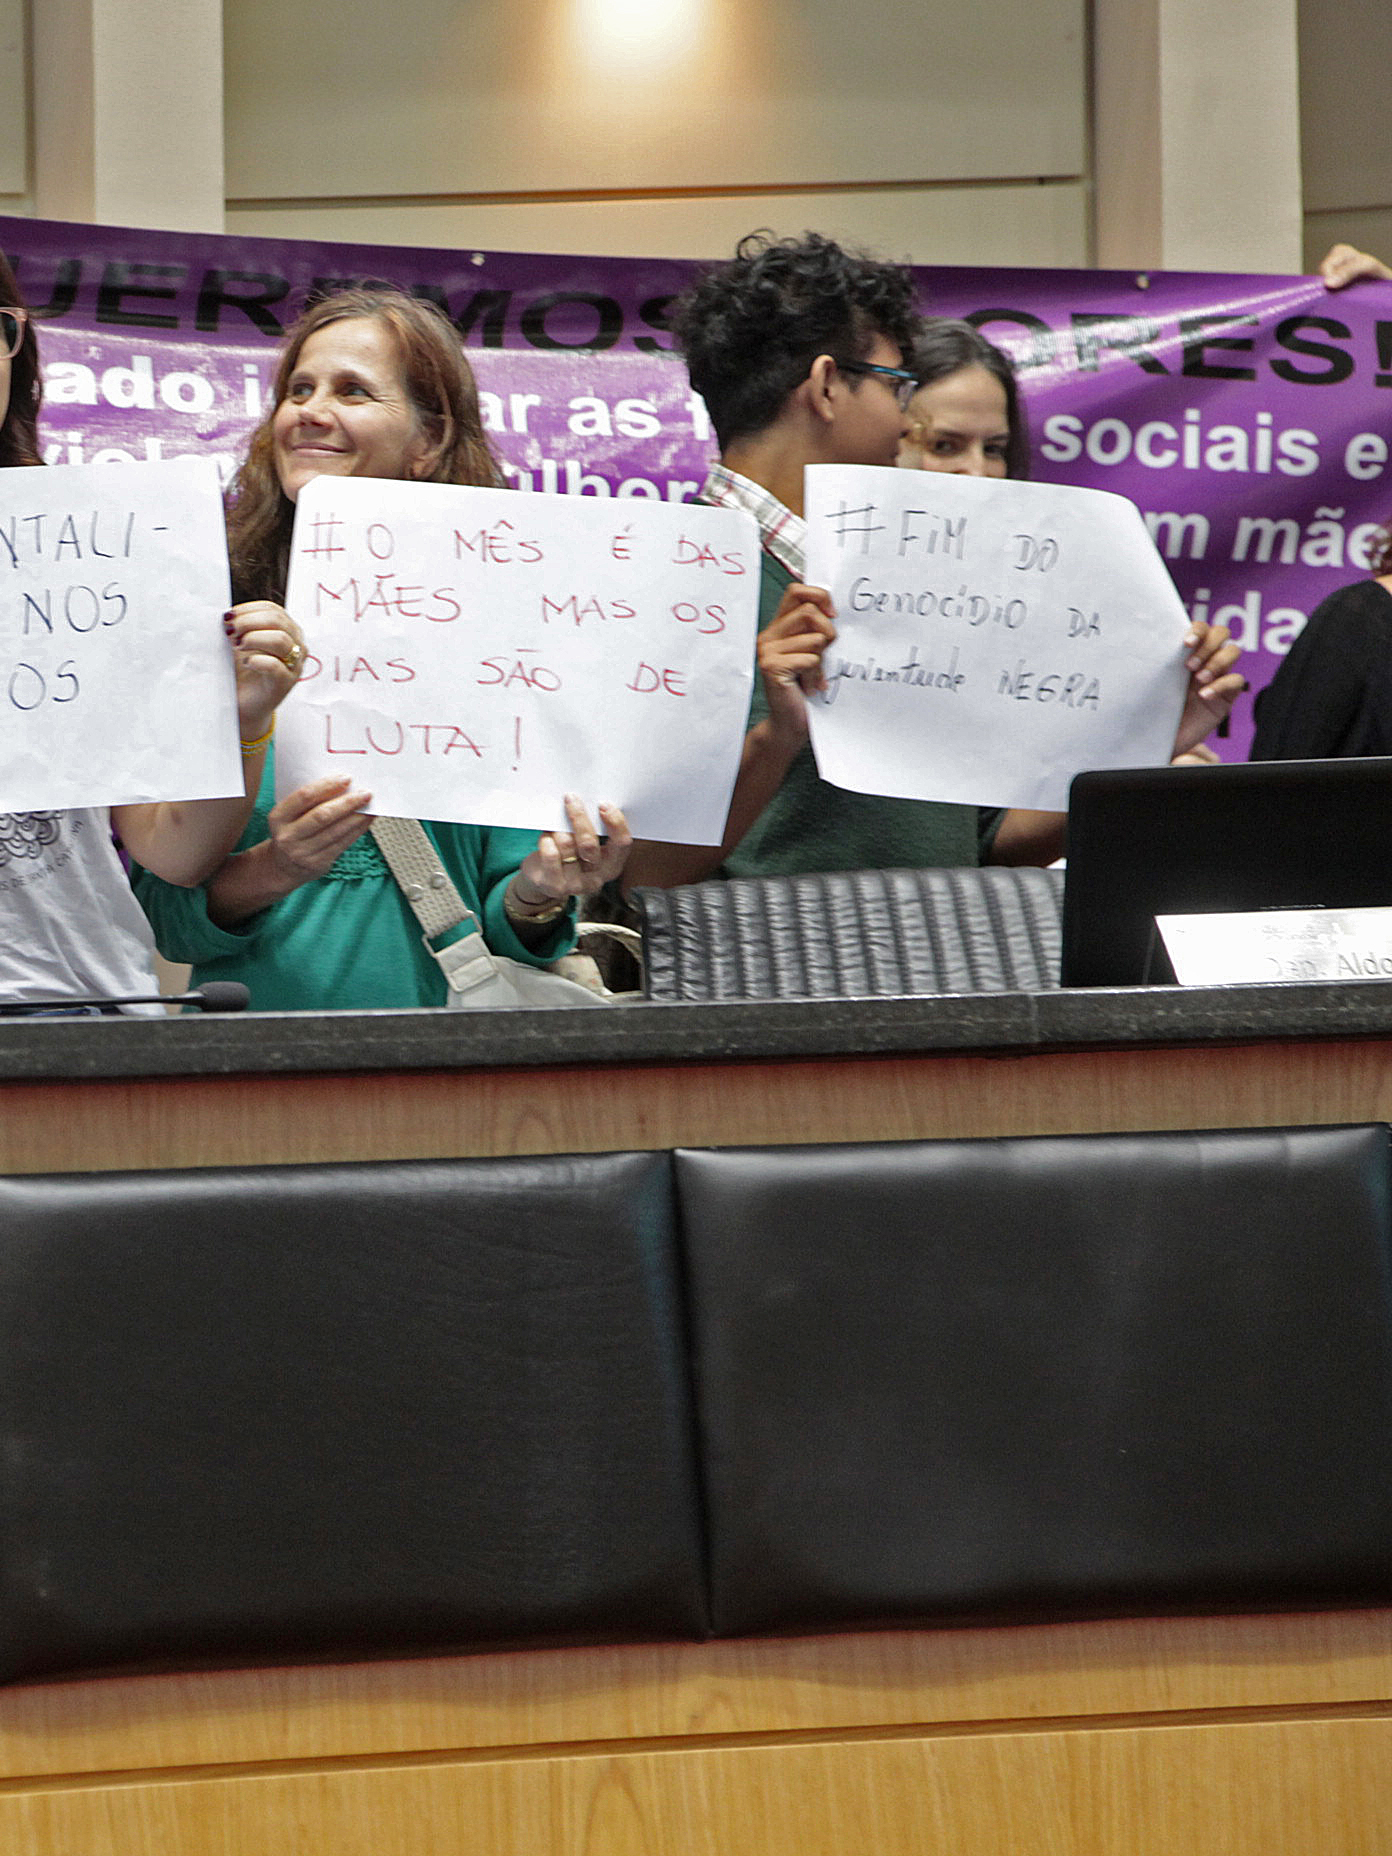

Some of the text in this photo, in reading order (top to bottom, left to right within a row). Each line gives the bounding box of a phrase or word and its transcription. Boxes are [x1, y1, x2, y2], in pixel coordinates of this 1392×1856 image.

[568, 395, 662, 440] as
[1040, 407, 1320, 477] sociais
[1344, 431, 1389, 481] e
[454, 519, 545, 564] MÊS
[611, 523, 635, 561] É
[671, 534, 746, 576] DAS
[1013, 533, 1059, 573] DO
[22, 582, 128, 635] NOS
[316, 573, 727, 634] MÃES MAS OS
[1066, 607, 1101, 639] DA
[476, 648, 562, 692] SÃO
[625, 662, 688, 697] DE
[997, 658, 1101, 711] NEGRA
